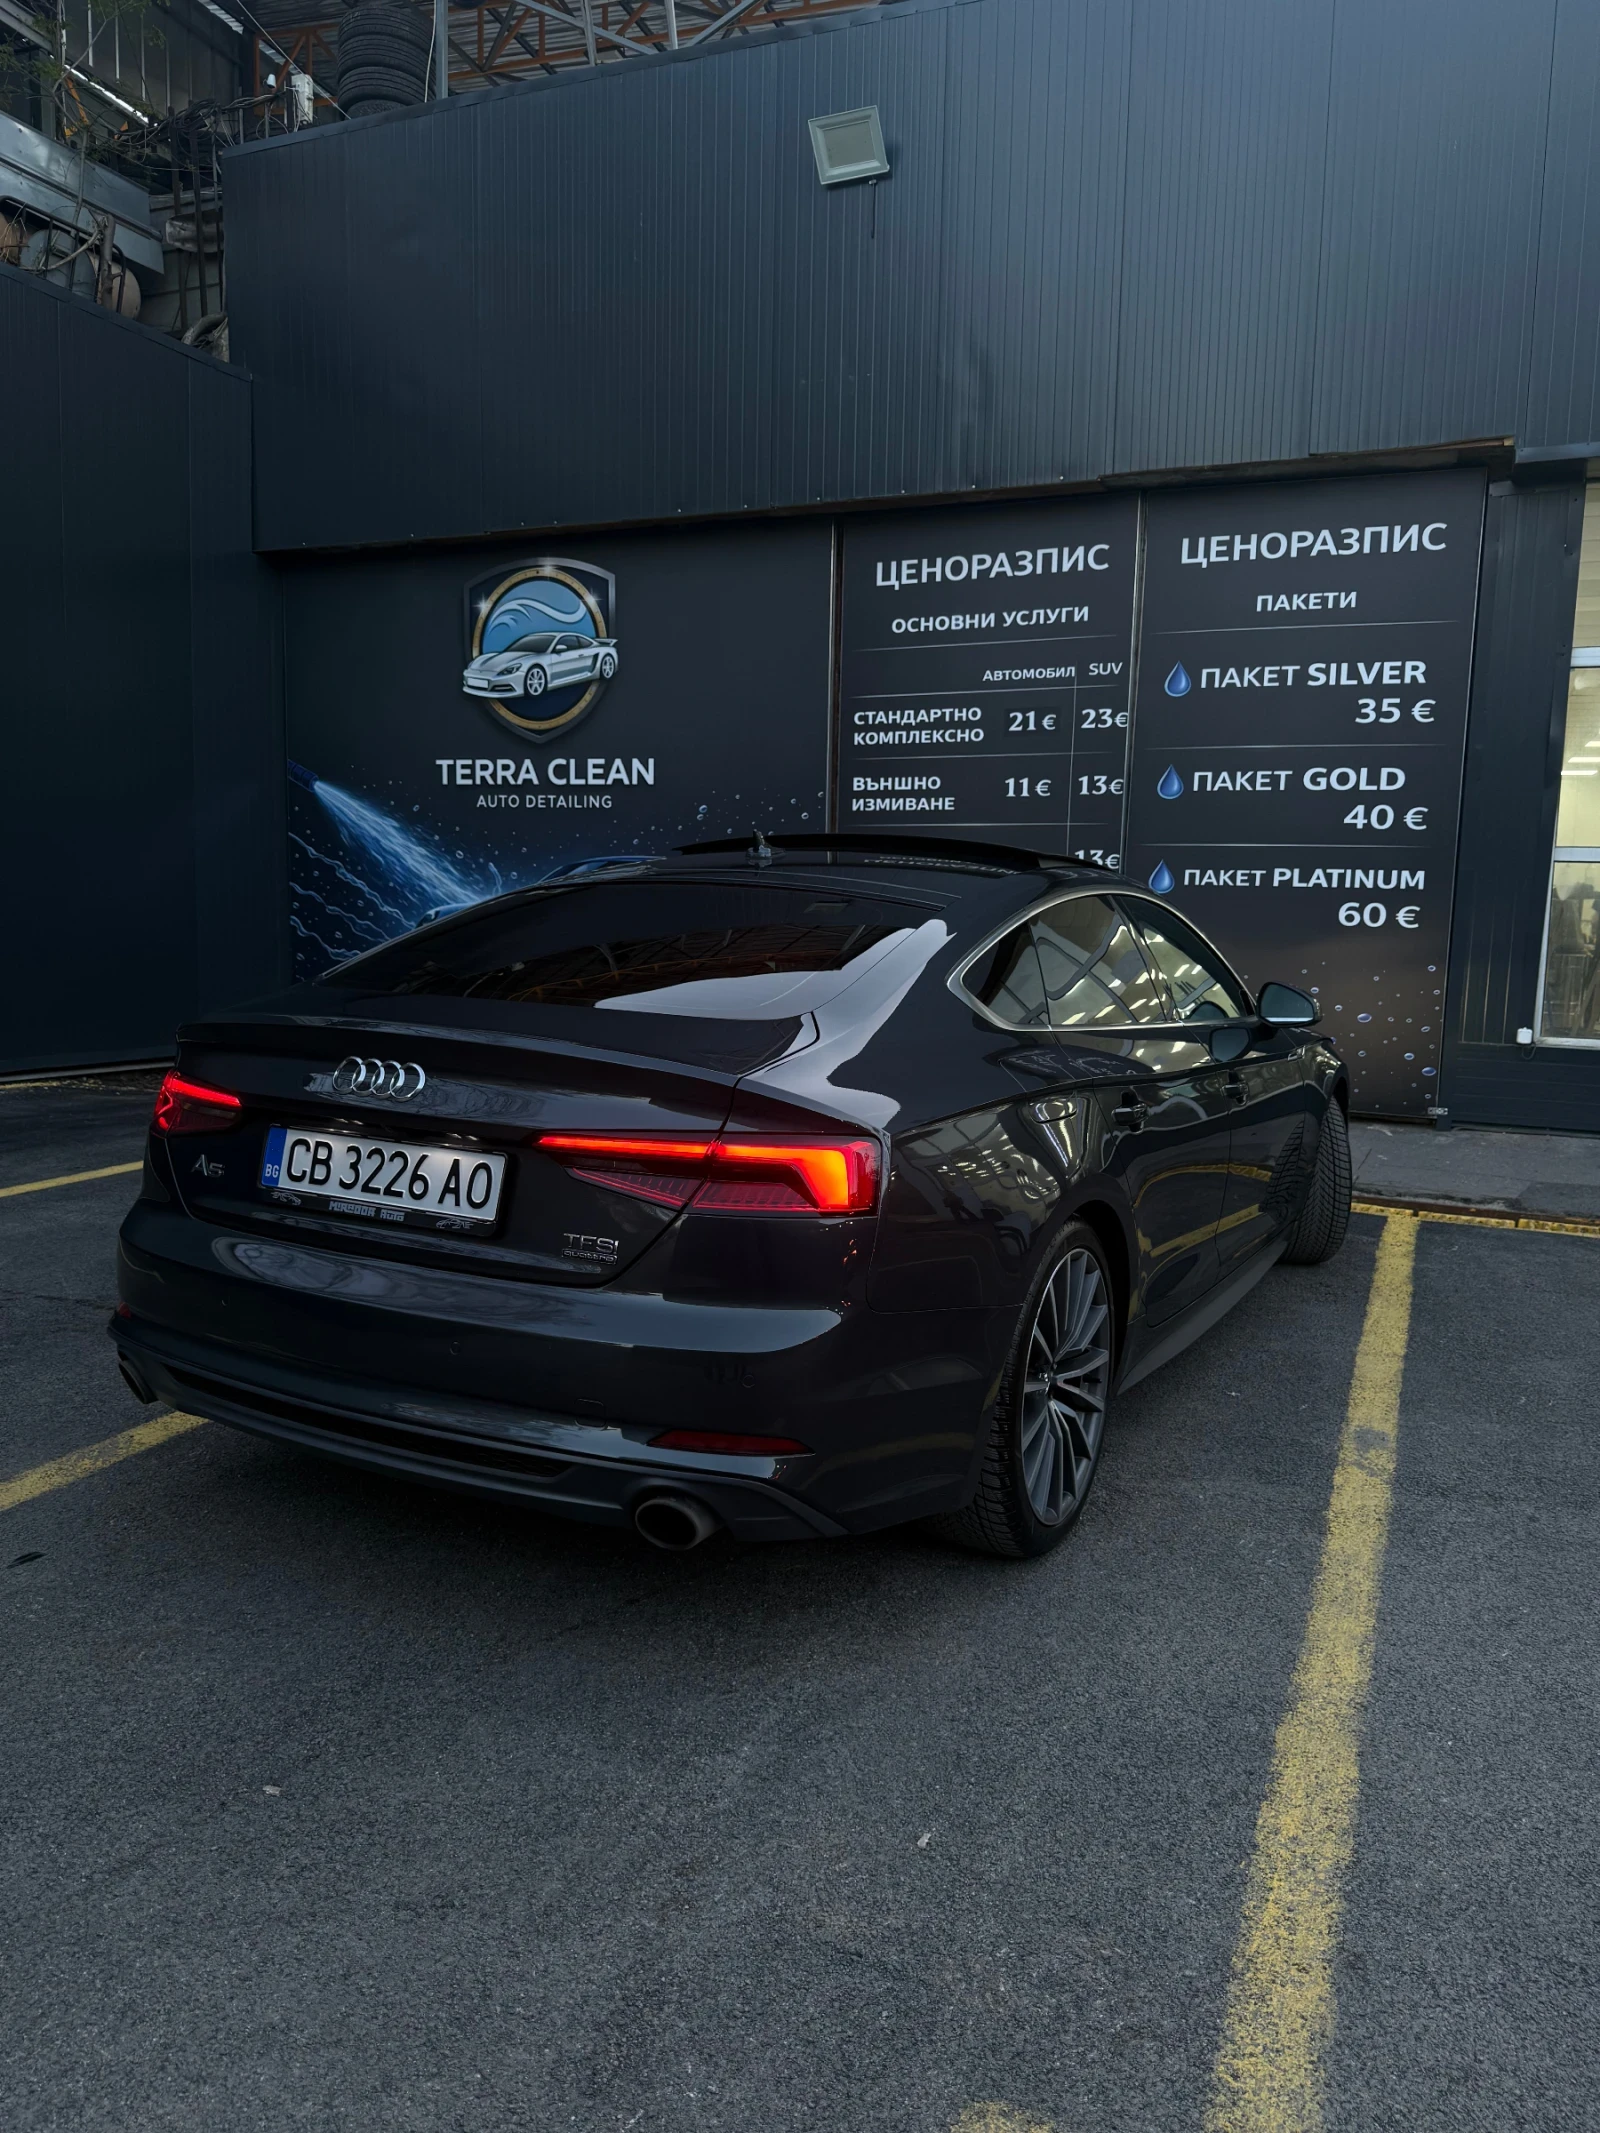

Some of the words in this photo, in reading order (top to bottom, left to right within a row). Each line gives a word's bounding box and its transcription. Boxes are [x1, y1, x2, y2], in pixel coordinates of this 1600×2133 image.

[1181, 522, 1448, 569] ЦЕНОРАЗПИС
[876, 543, 1110, 591] ЦЕНОРАЗПИС
[1256, 591, 1357, 612] ПАКЕТИ
[891, 612, 996, 634] ОСНОВНИ
[1002, 605, 1089, 627] УСЛУГИ
[982, 666, 1076, 682] АВТОМОБИЛ
[1088, 661, 1123, 676] SUV
[1200, 665, 1301, 689] ПАКЕТ
[1307, 660, 1427, 687] SILVER
[853, 707, 982, 727] СТАНДАРТНО
[853, 728, 985, 746] КОМПЛЕКСНО
[435, 758, 540, 785] TERRA
[547, 757, 655, 786] CLEAN
[1193, 770, 1293, 792] ПАКЕТ
[1302, 767, 1406, 791] GOLD
[852, 776, 941, 791] ВЪНШНО
[1078, 775, 1124, 795] 13€
[476, 794, 520, 808] AUTO
[525, 794, 612, 809] DETAILING
[852, 797, 955, 812] ИЗМИВАНЕ
[1183, 869, 1267, 887] ПАКЕТ
[1272, 867, 1425, 890] PLATINUM
[191, 1154, 225, 1177] A5
[264, 1163, 280, 1178] BG
[286, 1138, 334, 1186] CB
[338, 1144, 431, 1200] 3226
[563, 1233, 620, 1255] TFSI
